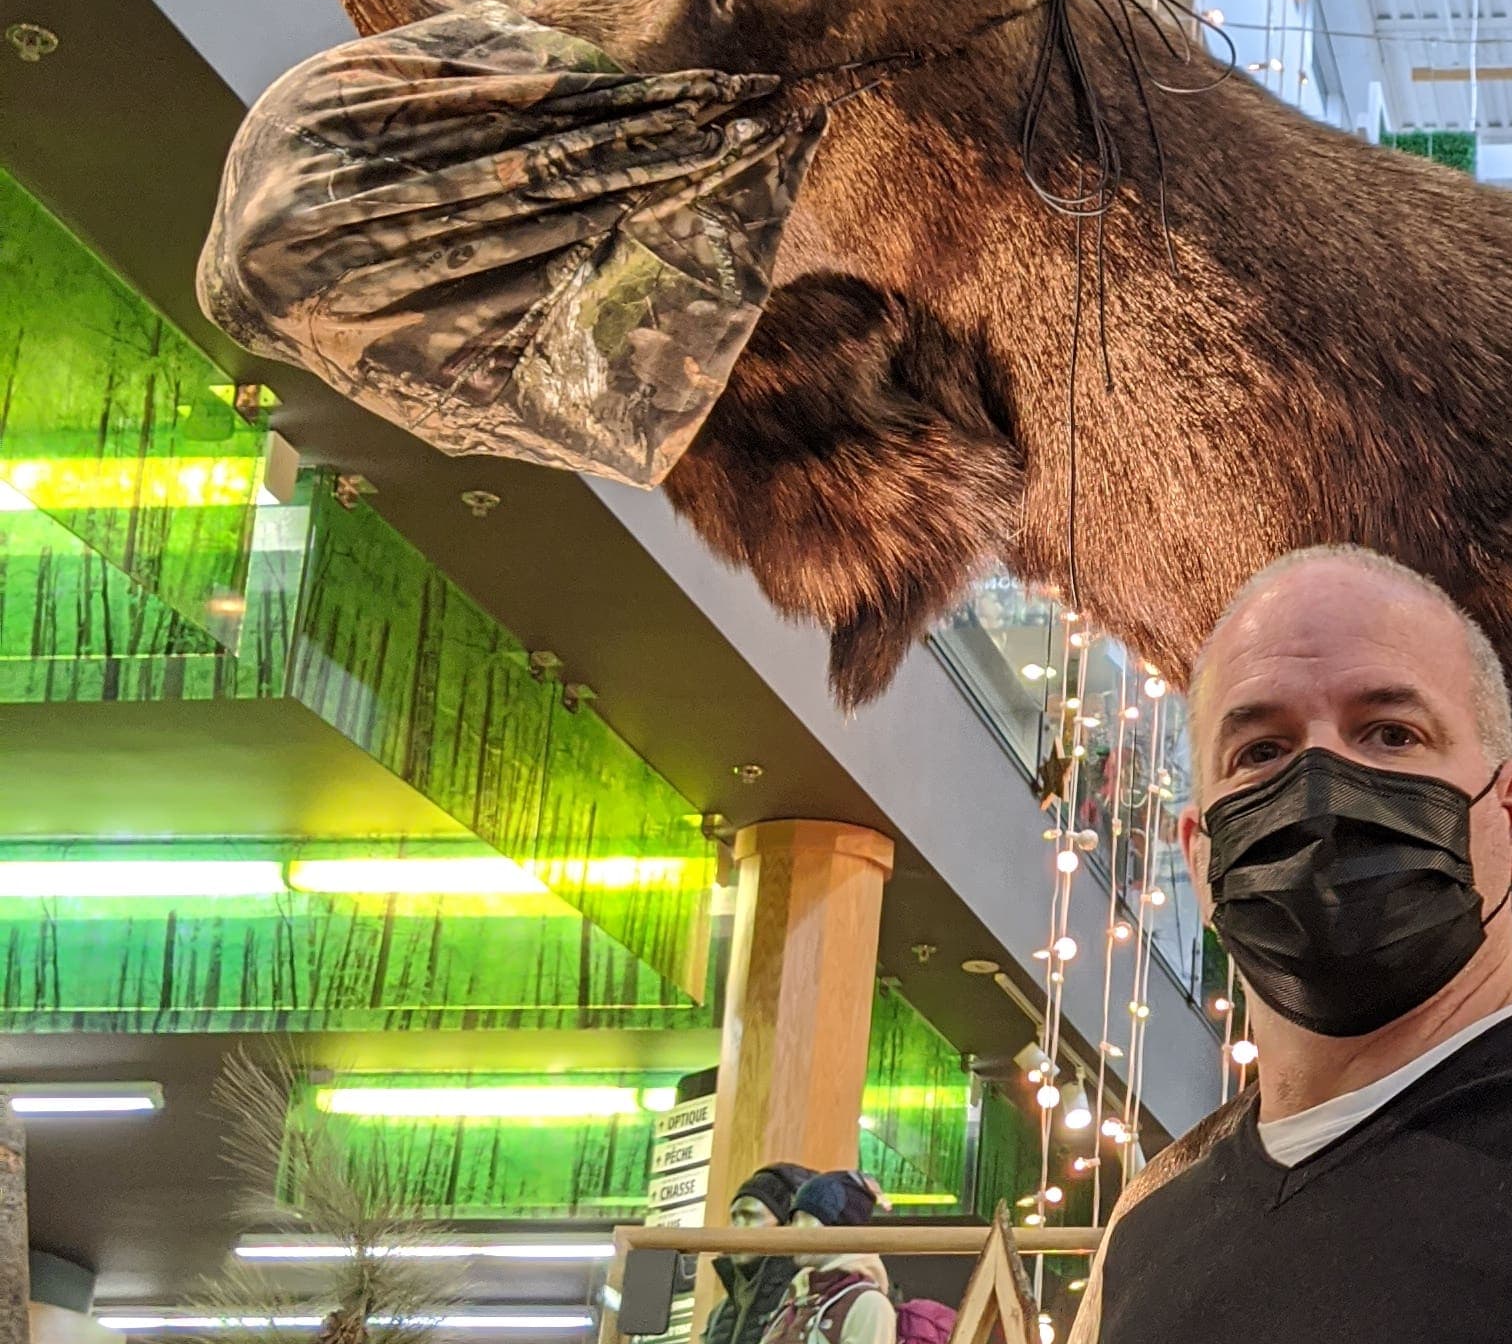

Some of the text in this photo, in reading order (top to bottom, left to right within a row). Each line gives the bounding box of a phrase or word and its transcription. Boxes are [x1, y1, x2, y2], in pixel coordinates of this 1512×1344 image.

[668, 1106, 708, 1130] OPTIQUE
[664, 1144, 693, 1165] PÊCHE
[660, 1179, 697, 1201] CHASSE
